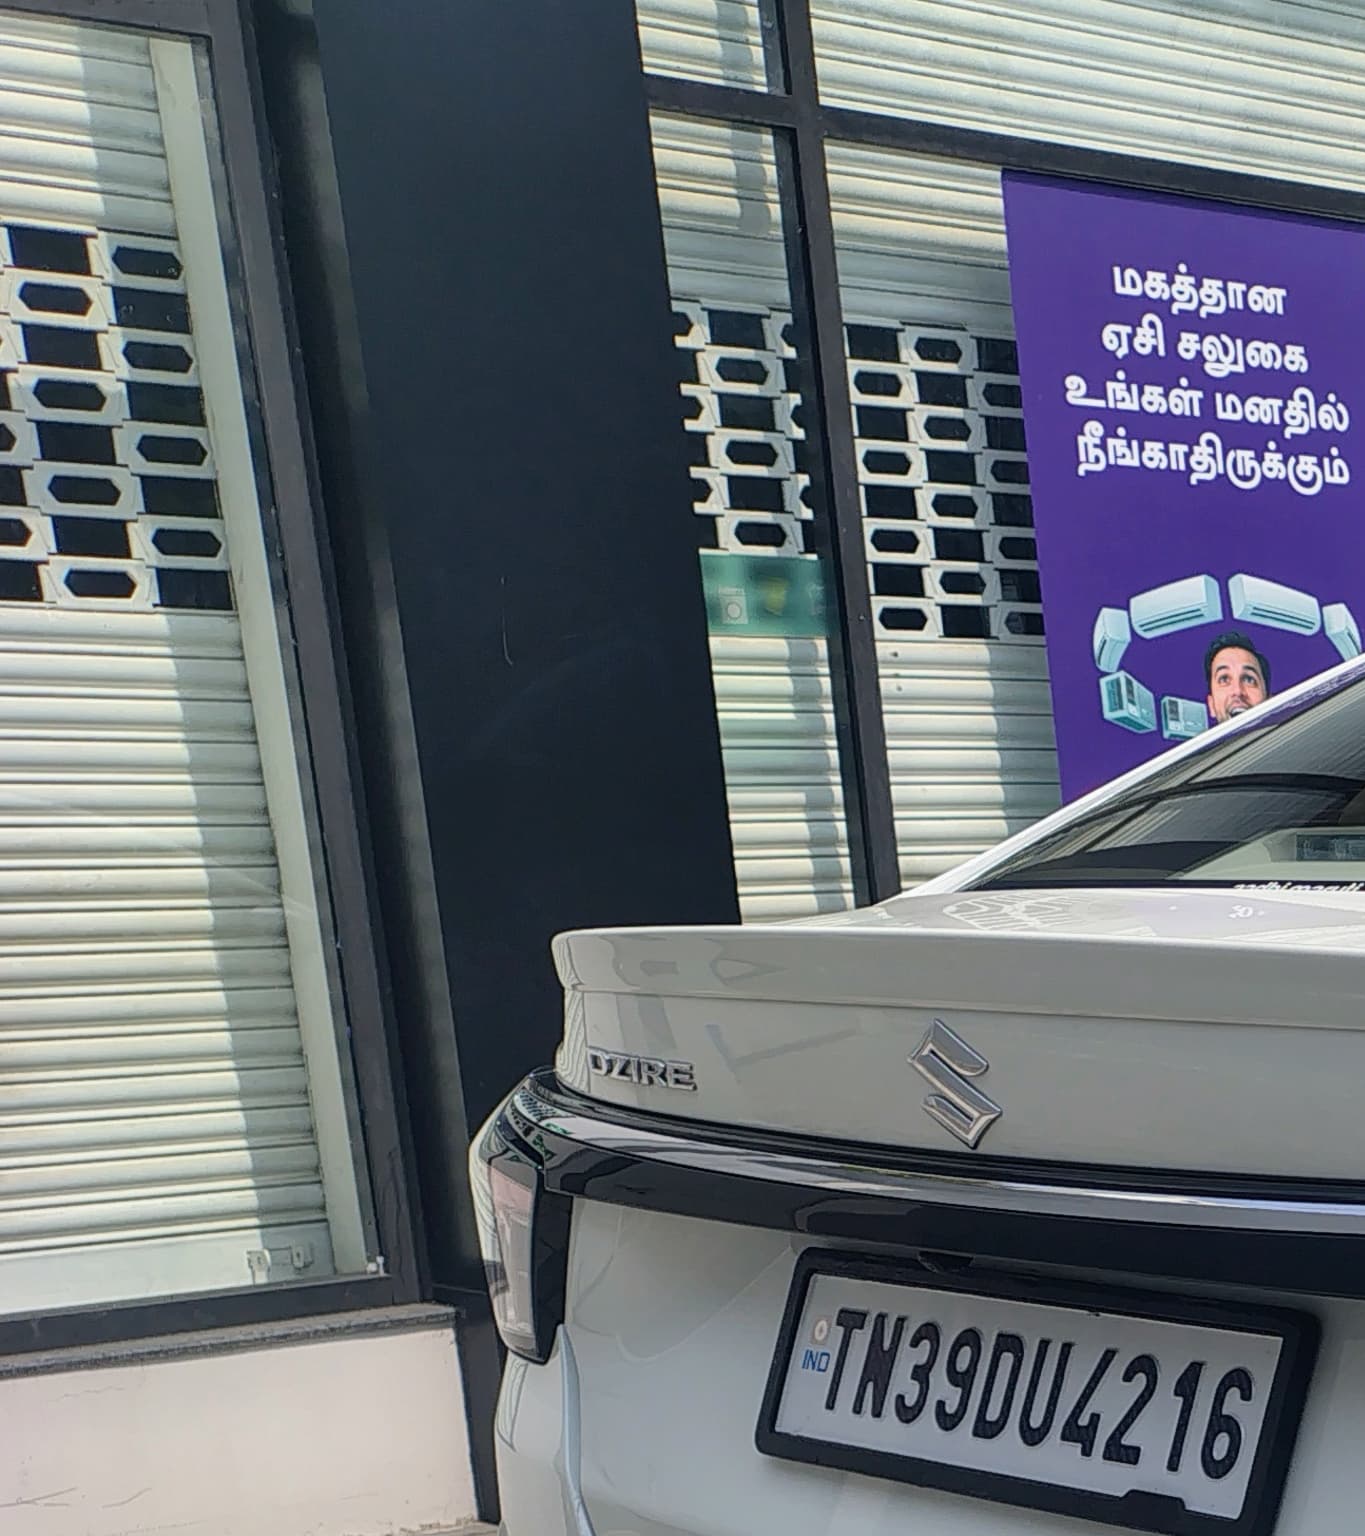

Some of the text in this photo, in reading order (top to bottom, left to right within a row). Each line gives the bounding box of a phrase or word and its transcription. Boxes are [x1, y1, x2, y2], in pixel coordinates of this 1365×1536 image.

[1112, 263, 1287, 318] மகத்தான
[1101, 313, 1309, 378] ஏசி சலுகை
[1064, 370, 1350, 439] உங்கள் மனதில்
[1077, 420, 1350, 496] நீங்காதிருக்கும்
[588, 1047, 698, 1092] DZIRE
[802, 1348, 830, 1375] IND
[824, 1306, 1255, 1481] TN39DU4216
